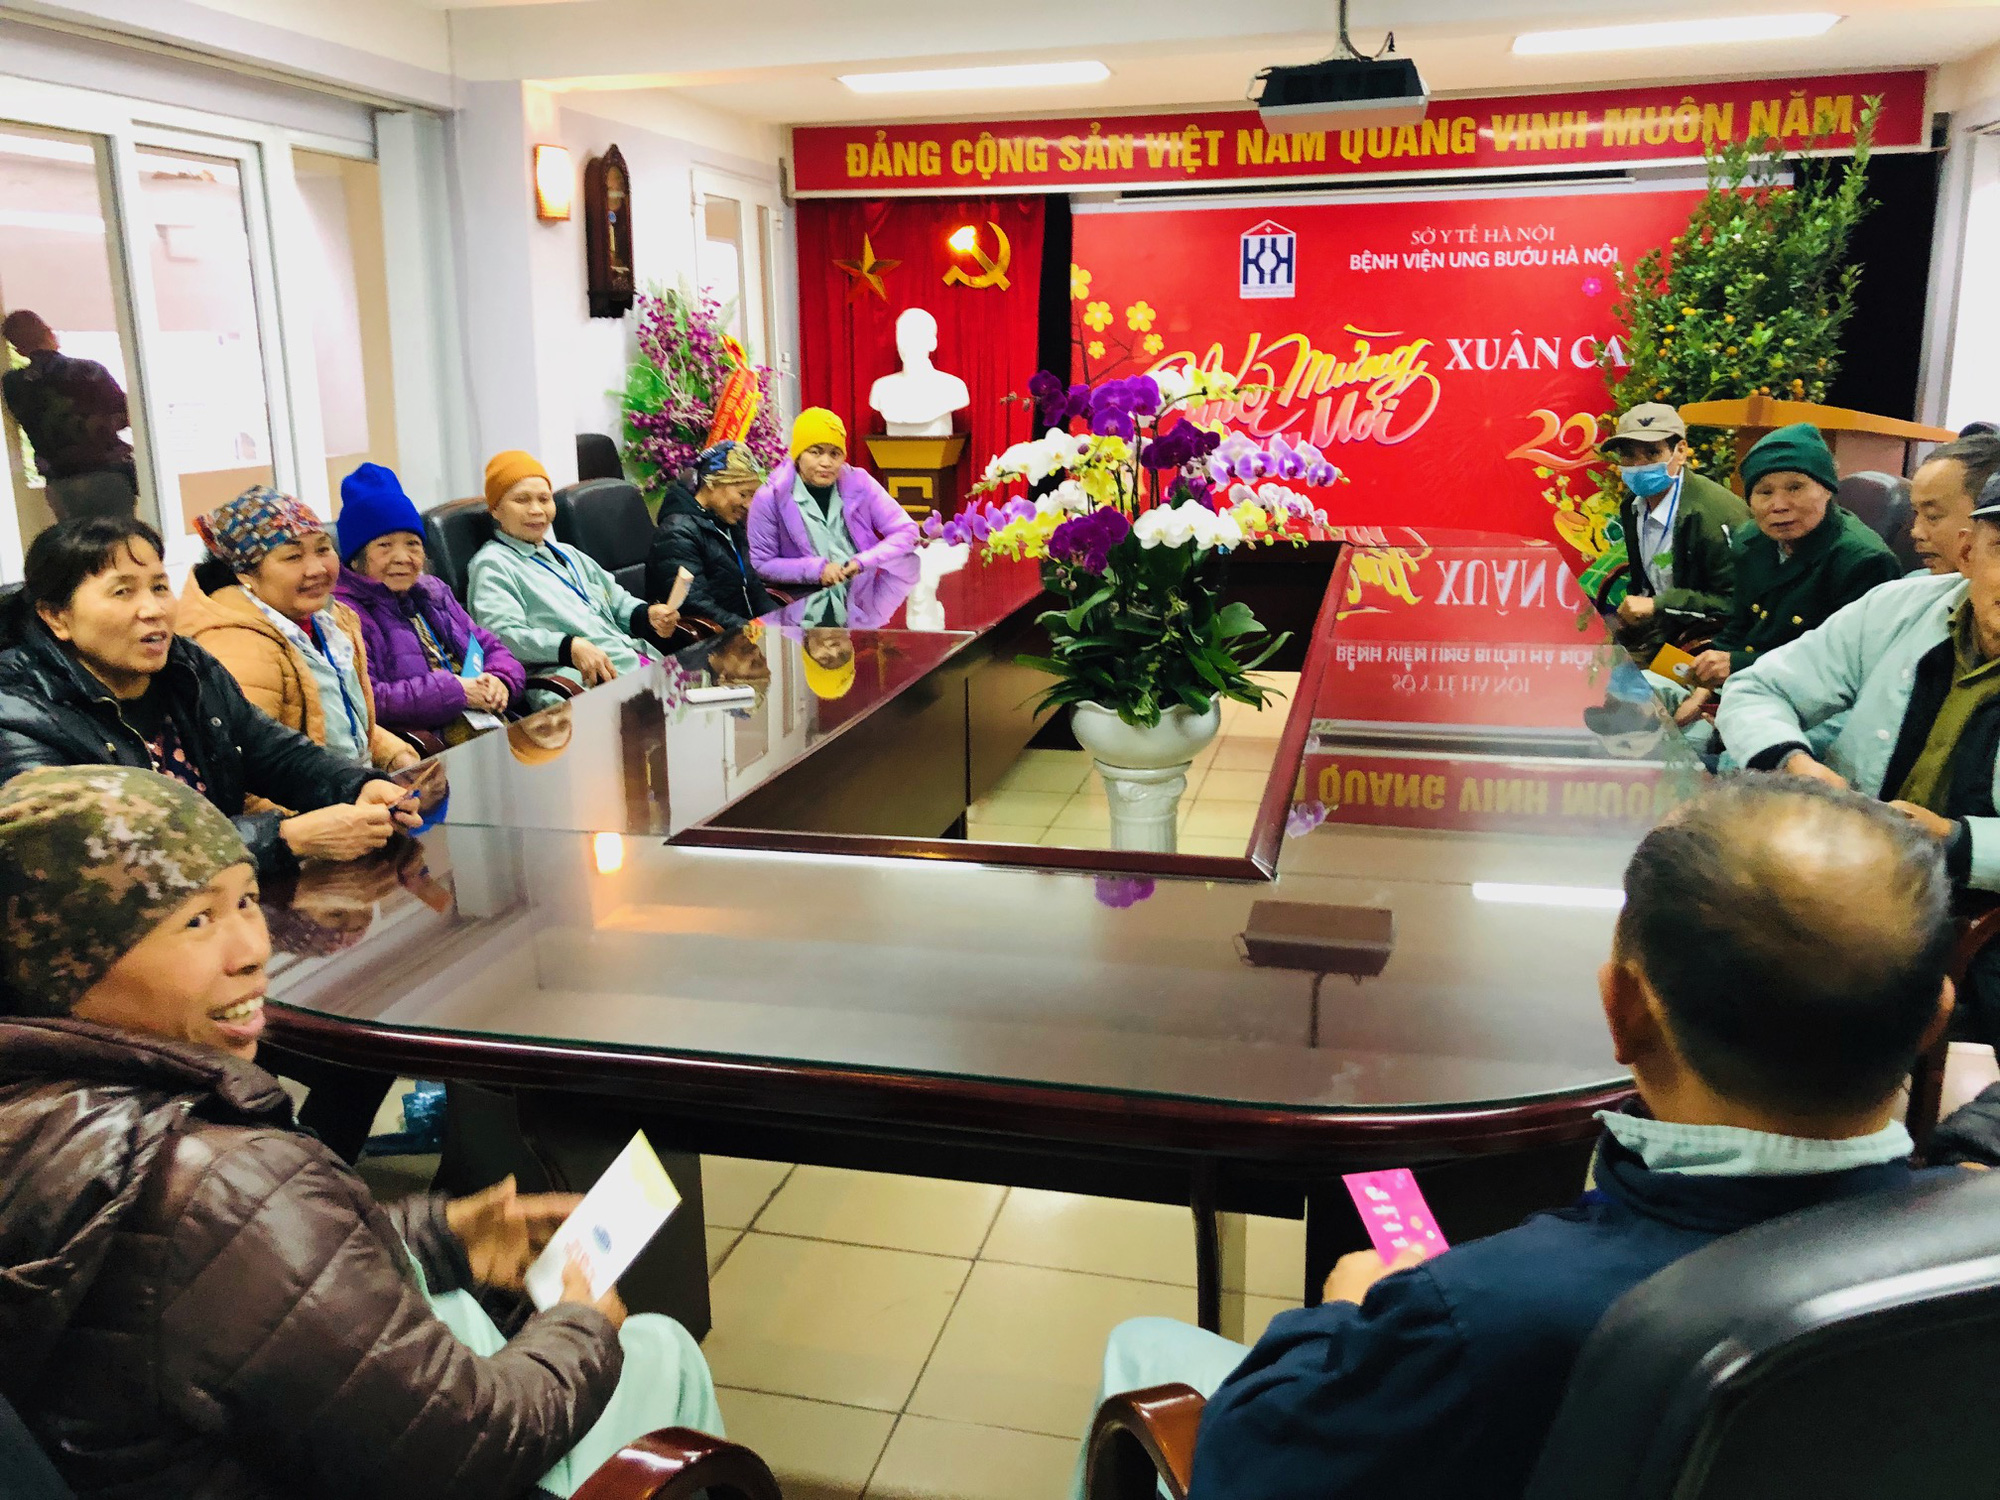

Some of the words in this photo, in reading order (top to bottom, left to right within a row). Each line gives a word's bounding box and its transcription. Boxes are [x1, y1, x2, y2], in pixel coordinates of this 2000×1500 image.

[846, 130, 941, 178] ĐẢNG
[951, 131, 1048, 180] CỘNG
[1058, 122, 1134, 172] SẢN
[1146, 124, 1224, 174] VIỆT
[1237, 128, 1326, 165] NAM
[1340, 116, 1476, 164] QUANG
[1492, 109, 1589, 152] VINH
[1602, 96, 1734, 147] MUÔN
[1750, 89, 1853, 138] NĂM
[1410, 226, 1437, 245] SỞ
[1440, 229, 1452, 244] Y
[1484, 225, 1512, 243] HÀ
[1516, 223, 1555, 245] NỘI
[1350, 249, 1398, 273] BỆNH
[1403, 248, 1445, 272] VIỆN
[1449, 251, 1490, 268] UNG
[1494, 245, 1548, 267] BƯỚU
[1552, 244, 1579, 265] HÀ
[1584, 242, 1618, 267] NỘI
[1444, 328, 1561, 370] XUÂN
[1570, 333, 1635, 369] CA
